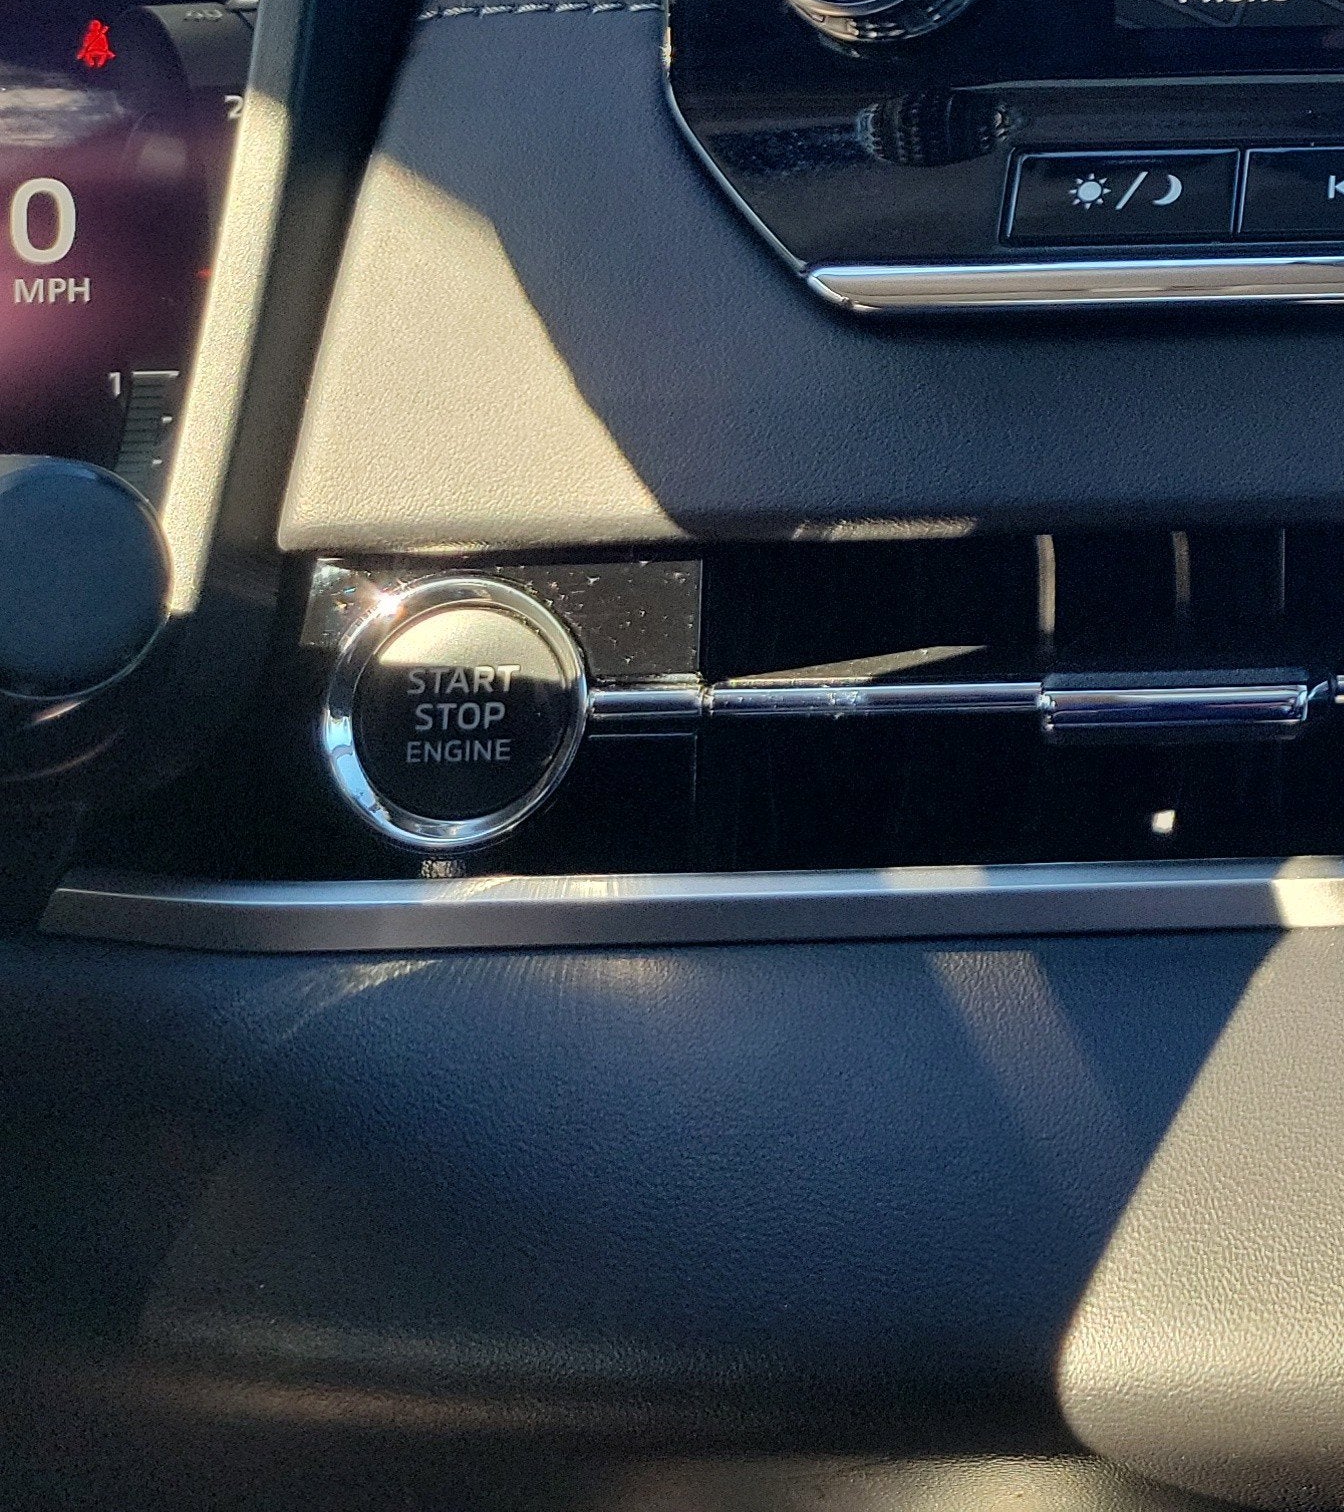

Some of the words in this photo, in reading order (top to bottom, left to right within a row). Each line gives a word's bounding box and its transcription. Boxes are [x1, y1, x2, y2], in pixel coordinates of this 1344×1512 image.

[9, 178, 77, 265] 0
[14, 278, 91, 304] MPH
[108, 372, 122, 397] 1
[407, 664, 522, 695] START
[414, 702, 506, 732] STOP
[406, 739, 512, 764] ENGINE
